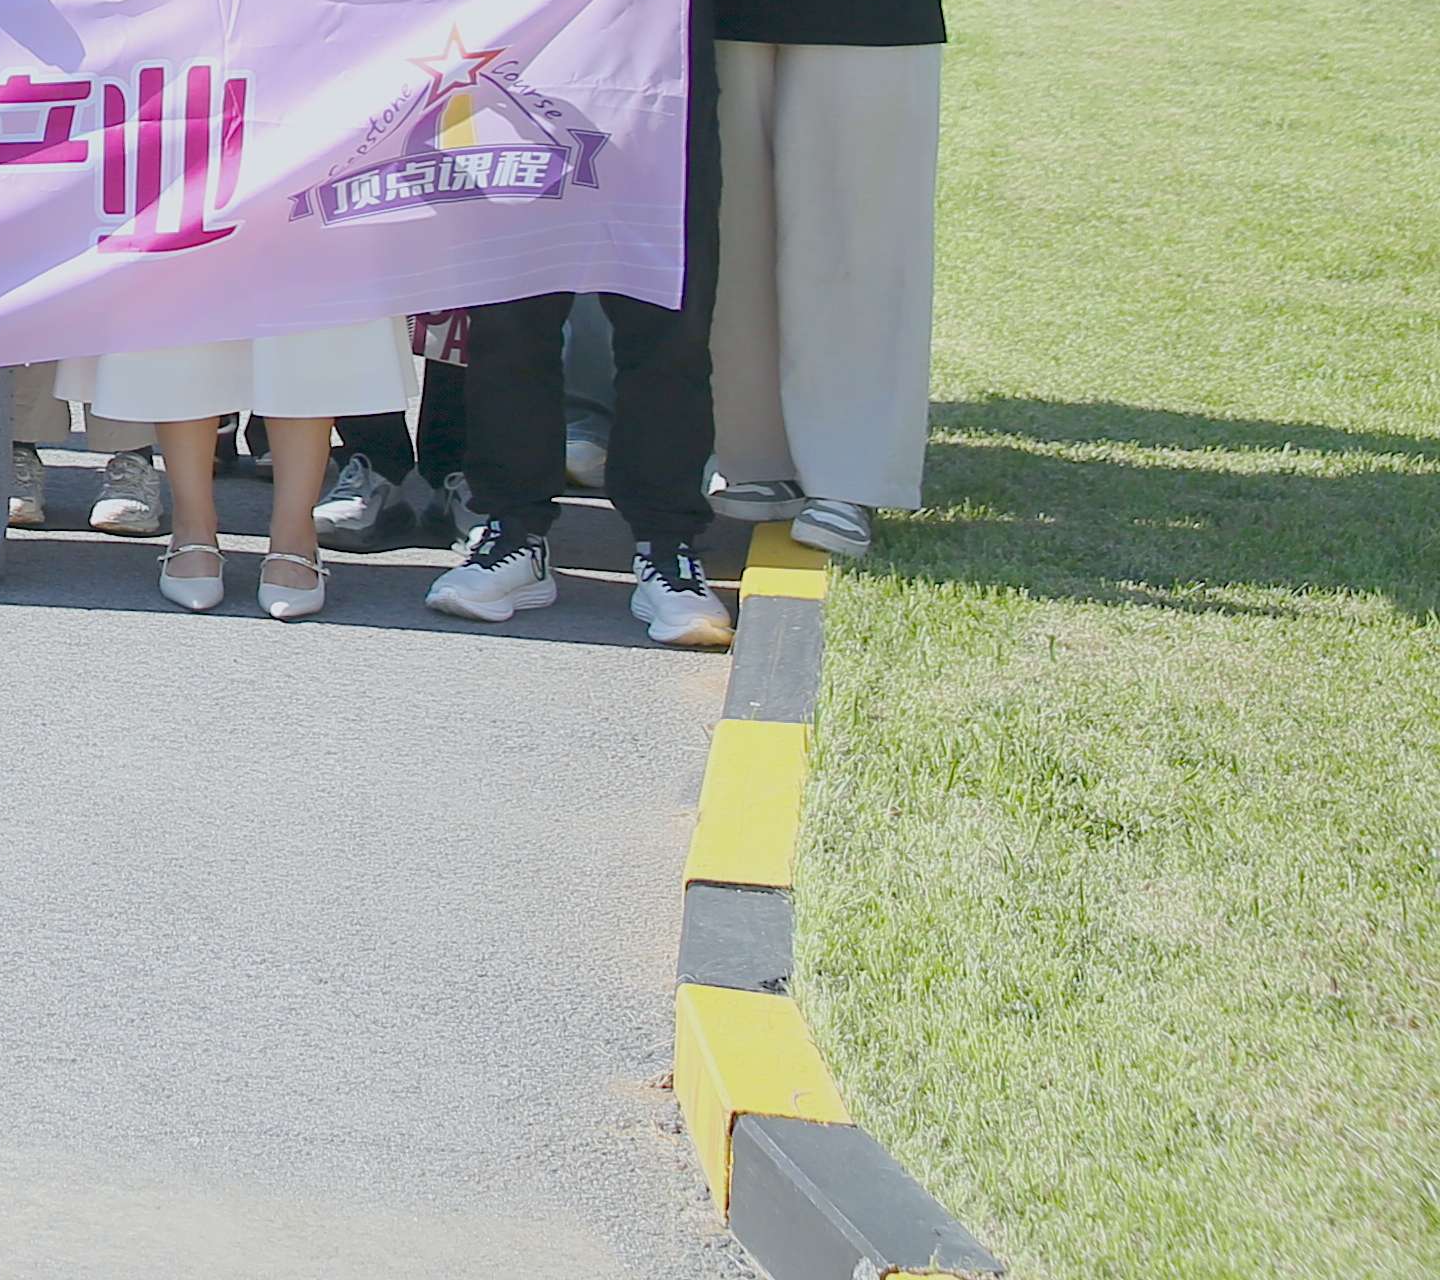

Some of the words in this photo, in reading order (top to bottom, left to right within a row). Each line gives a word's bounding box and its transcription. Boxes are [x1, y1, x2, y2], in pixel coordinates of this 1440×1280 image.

[490, 60, 563, 120] Course
[330, 150, 553, 216] 顶点课程
